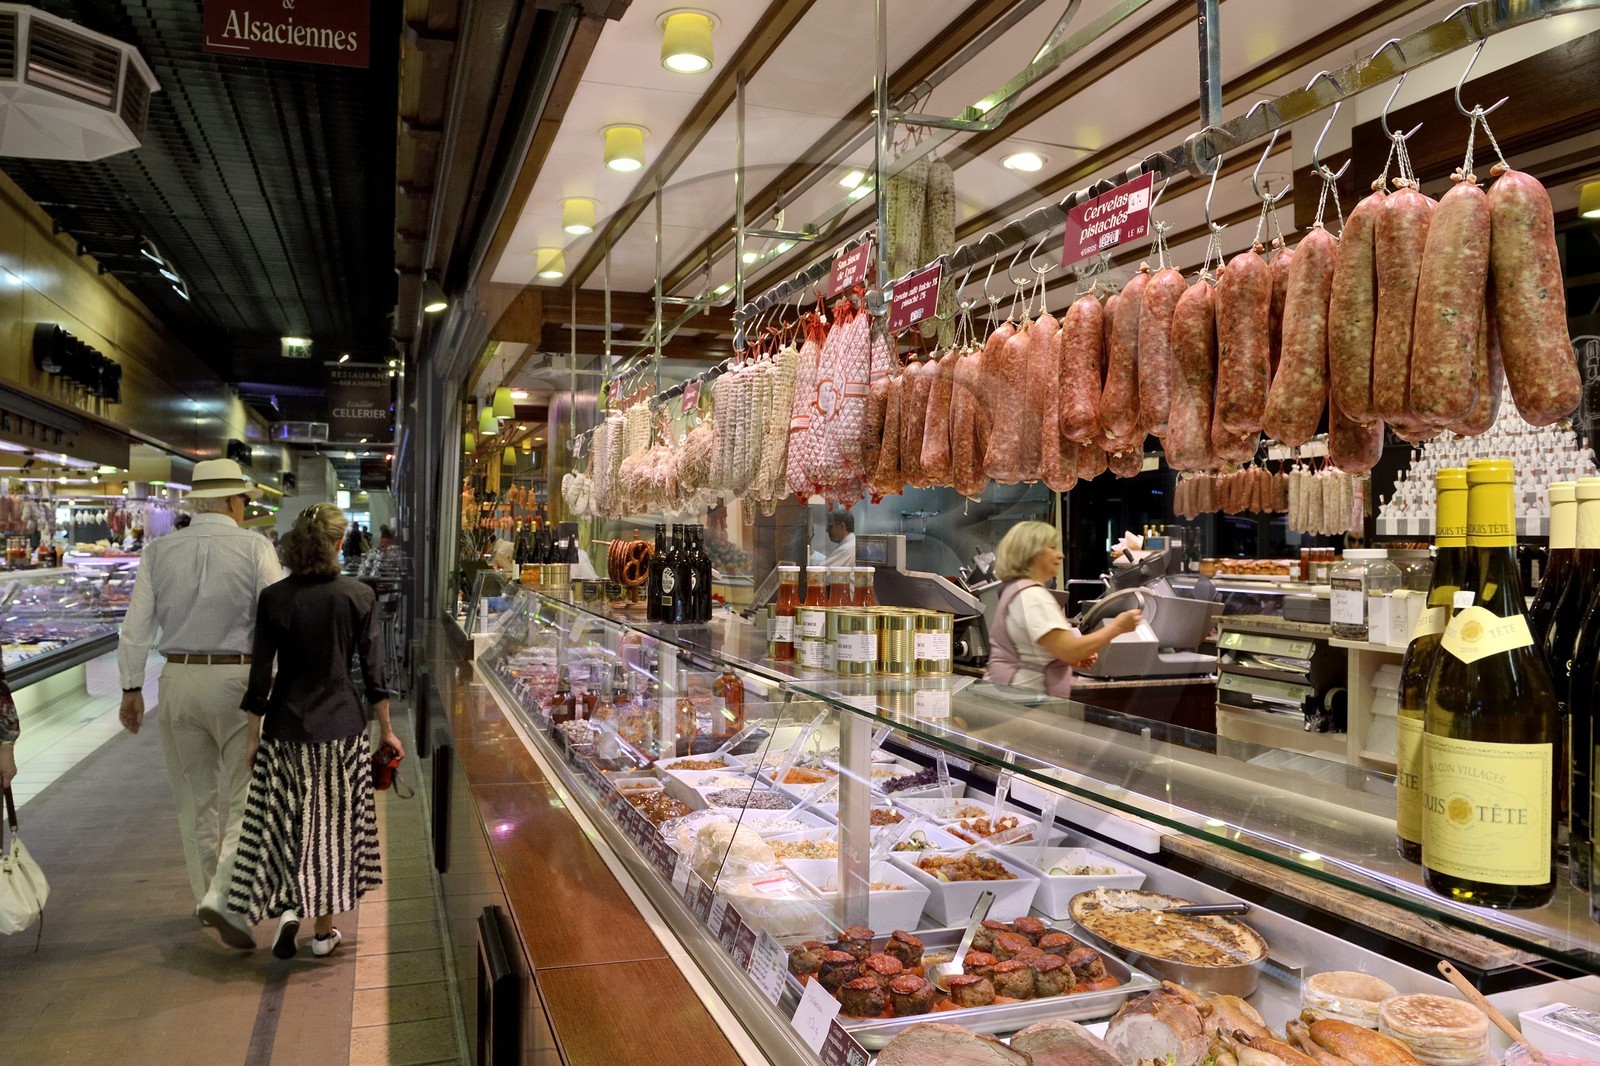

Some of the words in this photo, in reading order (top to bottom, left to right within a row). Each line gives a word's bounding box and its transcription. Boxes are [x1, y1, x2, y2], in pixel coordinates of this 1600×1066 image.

[221, 9, 358, 51] Alsaciennes
[1084, 193, 1129, 222] Cervelas
[1079, 210, 1129, 245] pistachés
[331, 370, 389, 379] RESTAURANT
[332, 408, 386, 419] CELLERIER
[1489, 623, 1517, 639] TÊTE
[1457, 764, 1506, 785] VILLAGES
[1475, 803, 1528, 825] TÊTE
